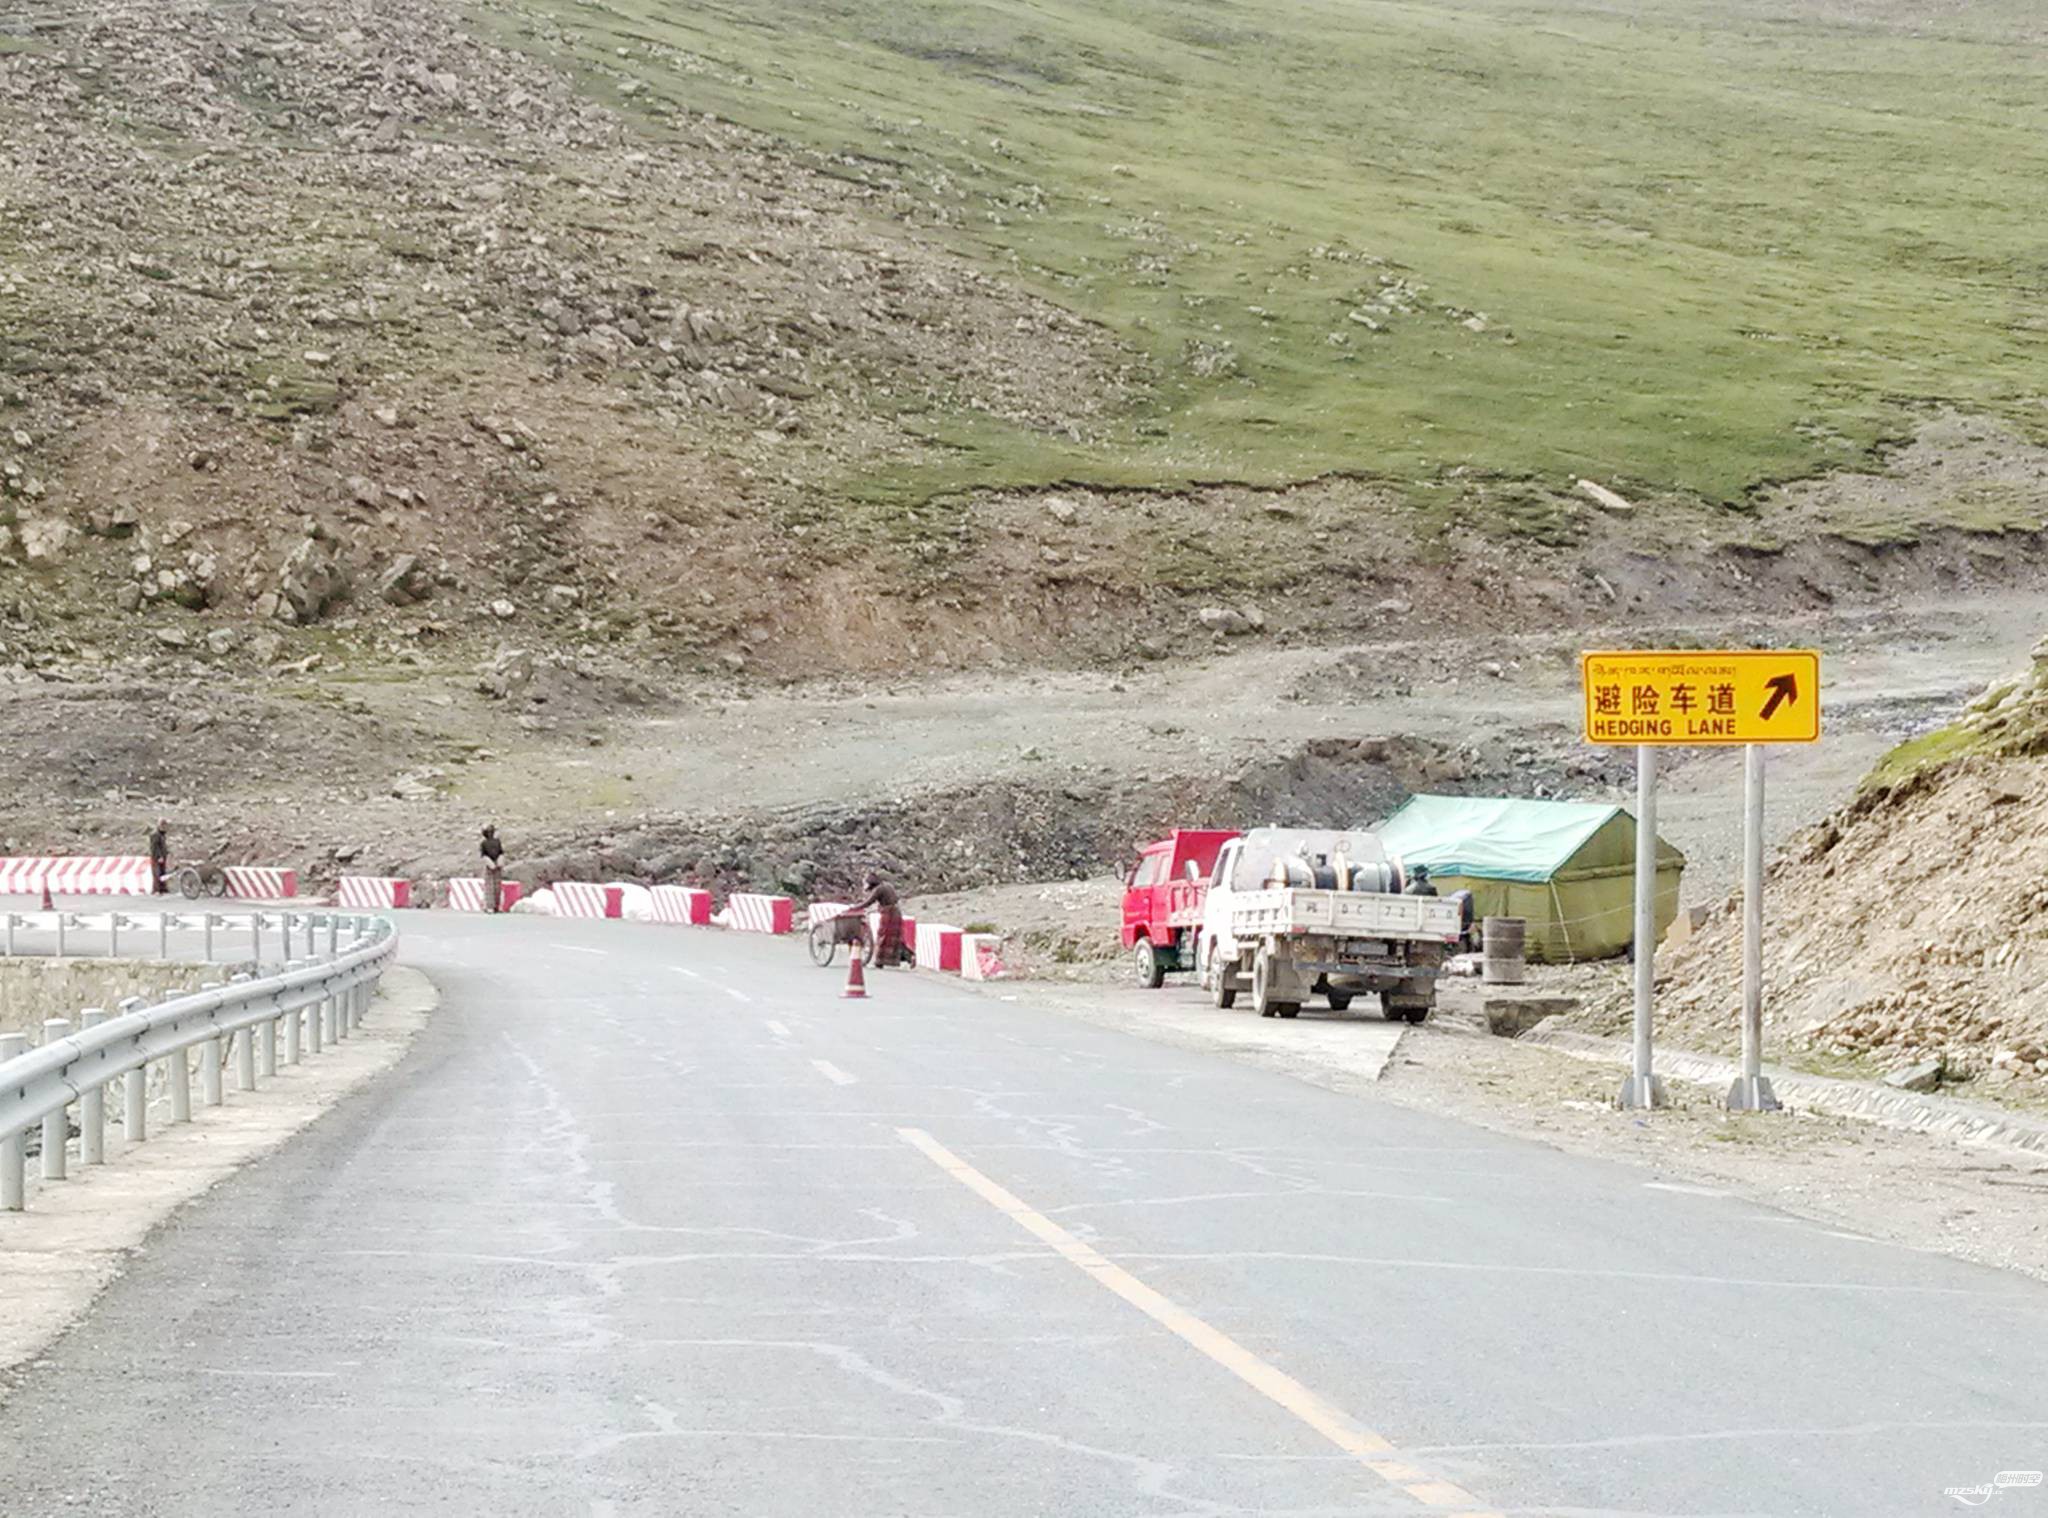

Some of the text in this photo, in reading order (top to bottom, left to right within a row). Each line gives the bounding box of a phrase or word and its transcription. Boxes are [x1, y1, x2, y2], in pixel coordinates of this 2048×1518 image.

[1594, 683, 1737, 715] 避险车道
[1594, 718, 1736, 736] HEDGING LANE
